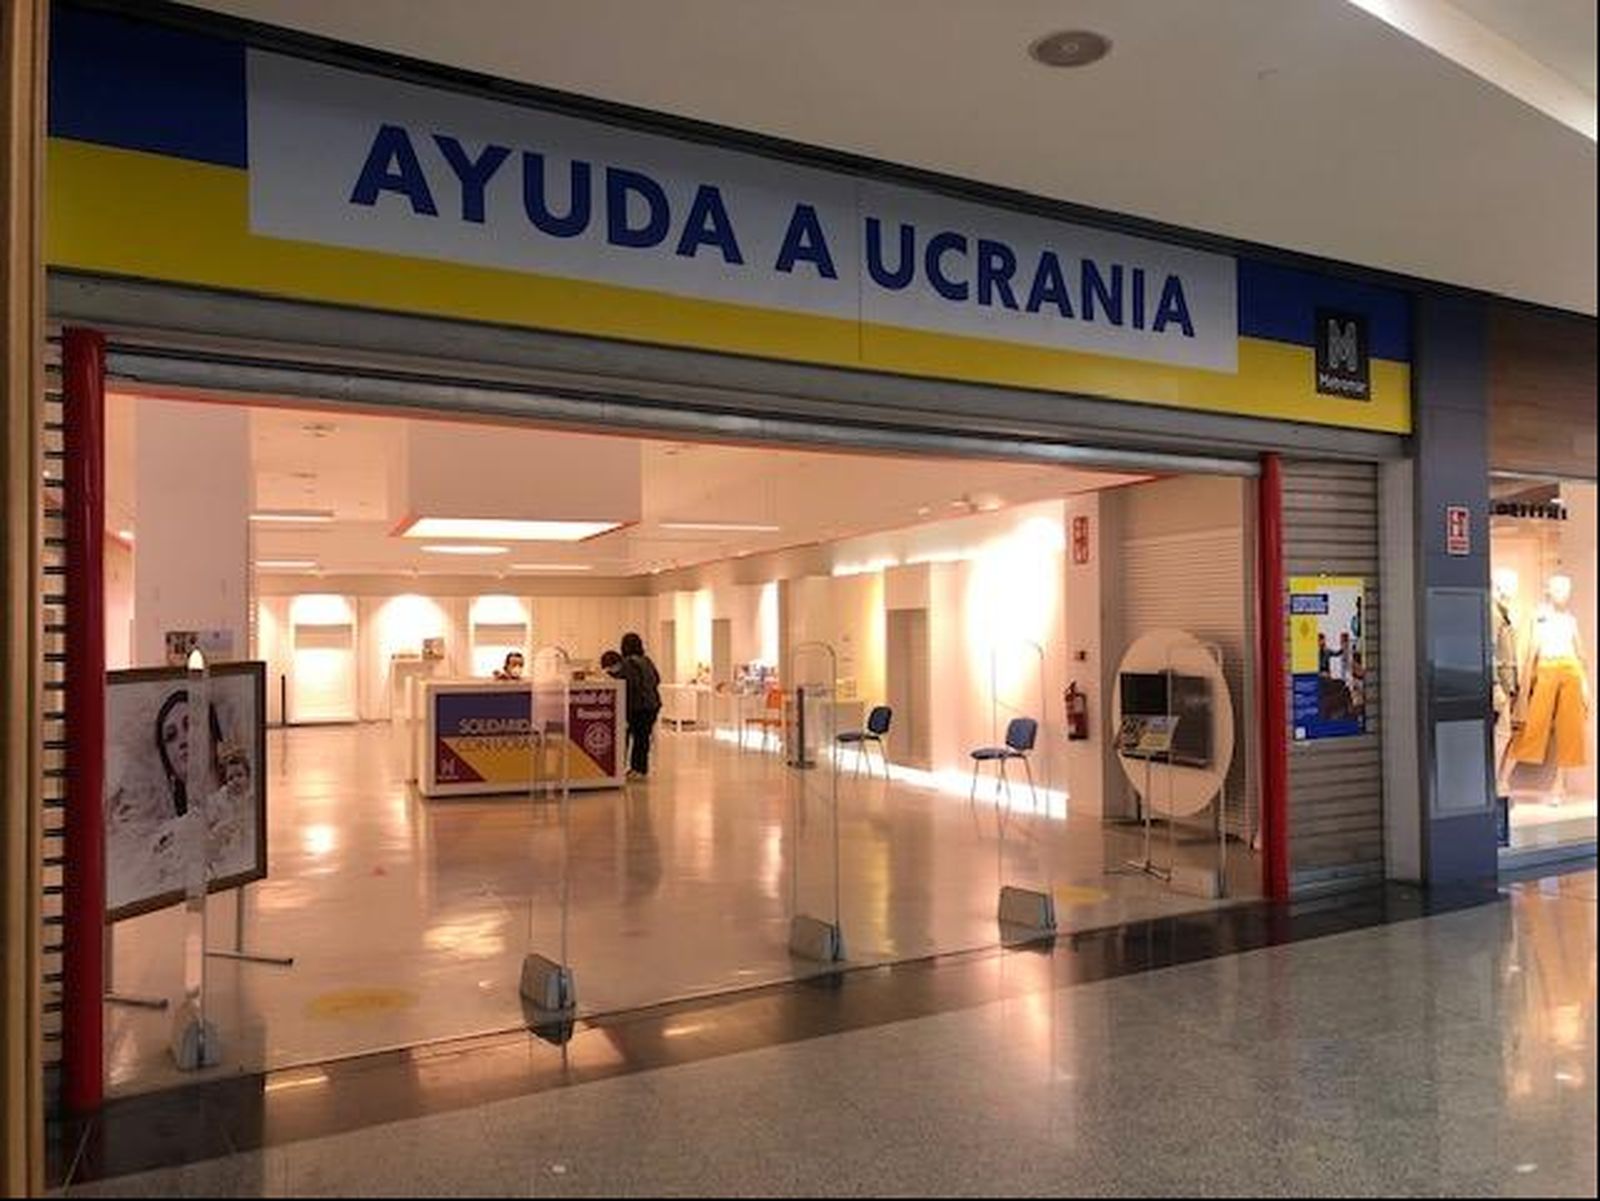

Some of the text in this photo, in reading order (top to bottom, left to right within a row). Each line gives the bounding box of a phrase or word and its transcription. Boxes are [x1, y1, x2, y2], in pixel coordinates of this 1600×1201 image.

[350, 123, 1196, 338] AYUDA A UCRANIA
